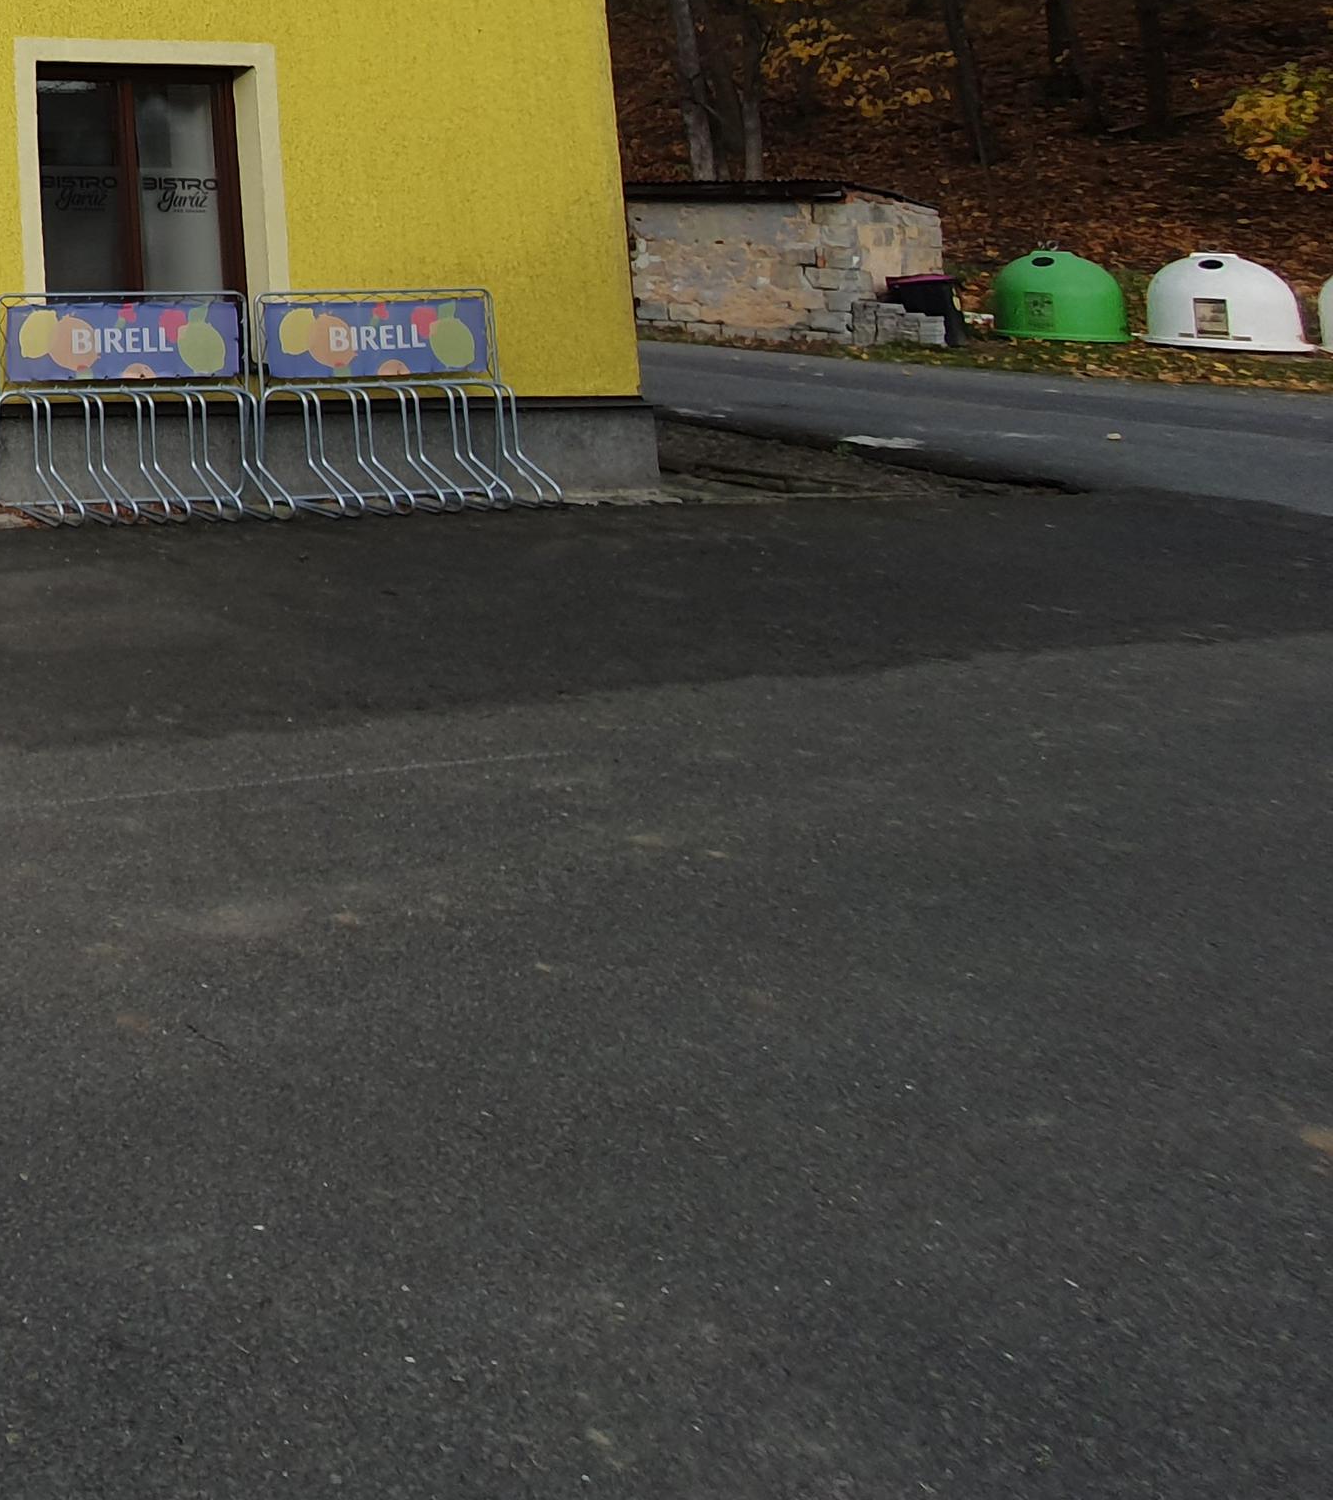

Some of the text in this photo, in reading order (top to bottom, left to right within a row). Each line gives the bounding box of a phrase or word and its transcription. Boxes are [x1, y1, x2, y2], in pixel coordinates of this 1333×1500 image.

[142, 177, 219, 191] BISTRO
[71, 326, 174, 355] BIRELL
[328, 323, 427, 352] BIRELL
